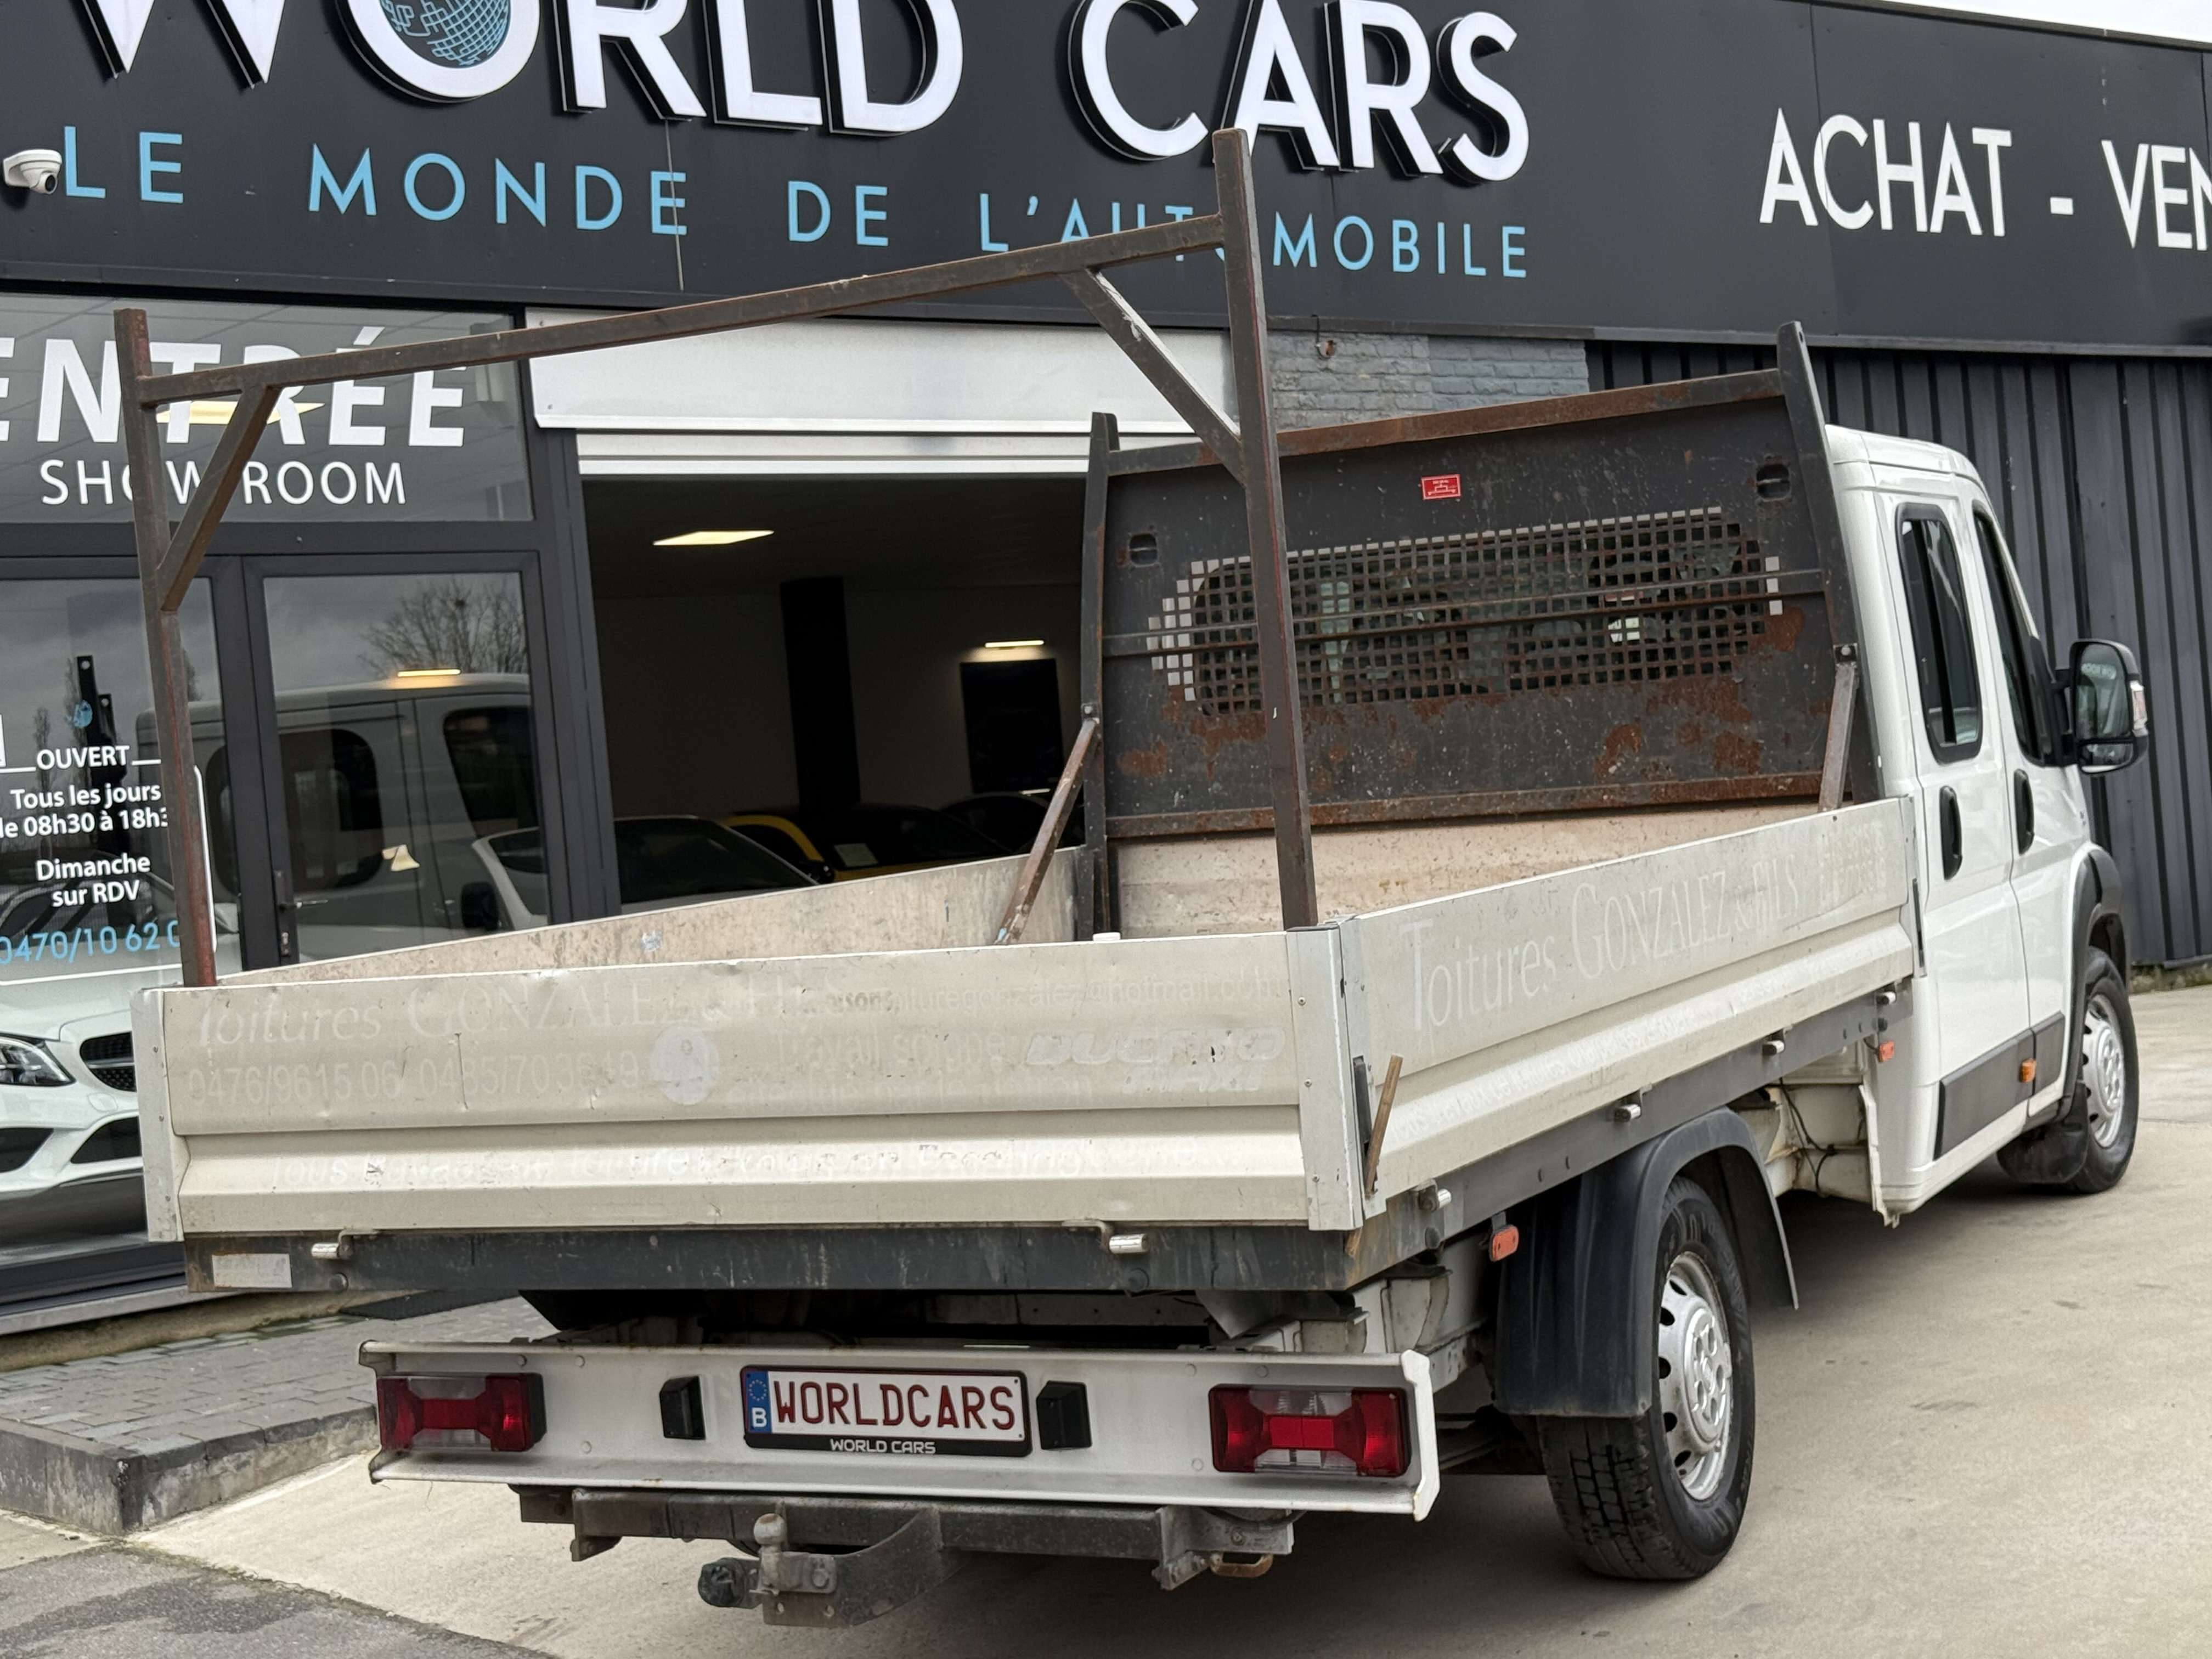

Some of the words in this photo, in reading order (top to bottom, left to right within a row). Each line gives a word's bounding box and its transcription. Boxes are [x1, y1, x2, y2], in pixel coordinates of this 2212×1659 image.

[1082, 0, 1528, 182] CARS
[1759, 108, 2012, 237] ACHAT
[64, 126, 184, 204] LE
[308, 144, 687, 235] MONDE
[787, 181, 889, 247] DE
[979, 194, 1527, 278] L'AUTMOBILE
[0, 326, 465, 447] NTRÉE
[37, 745, 130, 769] OUVERT
[10, 788, 64, 810] Tous
[70, 785, 101, 804] les
[104, 783, 162, 809] jours
[24, 812, 95, 837] 08h30
[100, 810, 113, 831] à
[36, 853, 151, 881] Dimanche
[52, 889, 87, 908] sur
[93, 880, 140, 904] RDV
[125, 922, 161, 952] 62
[1402, 919, 1556, 1032] Toitures
[751, 1407, 768, 1428] B
[774, 1380, 1015, 1430] WORLDCARS
[830, 1438, 887, 1453] WORLD
[891, 1440, 936, 1454] CARS
